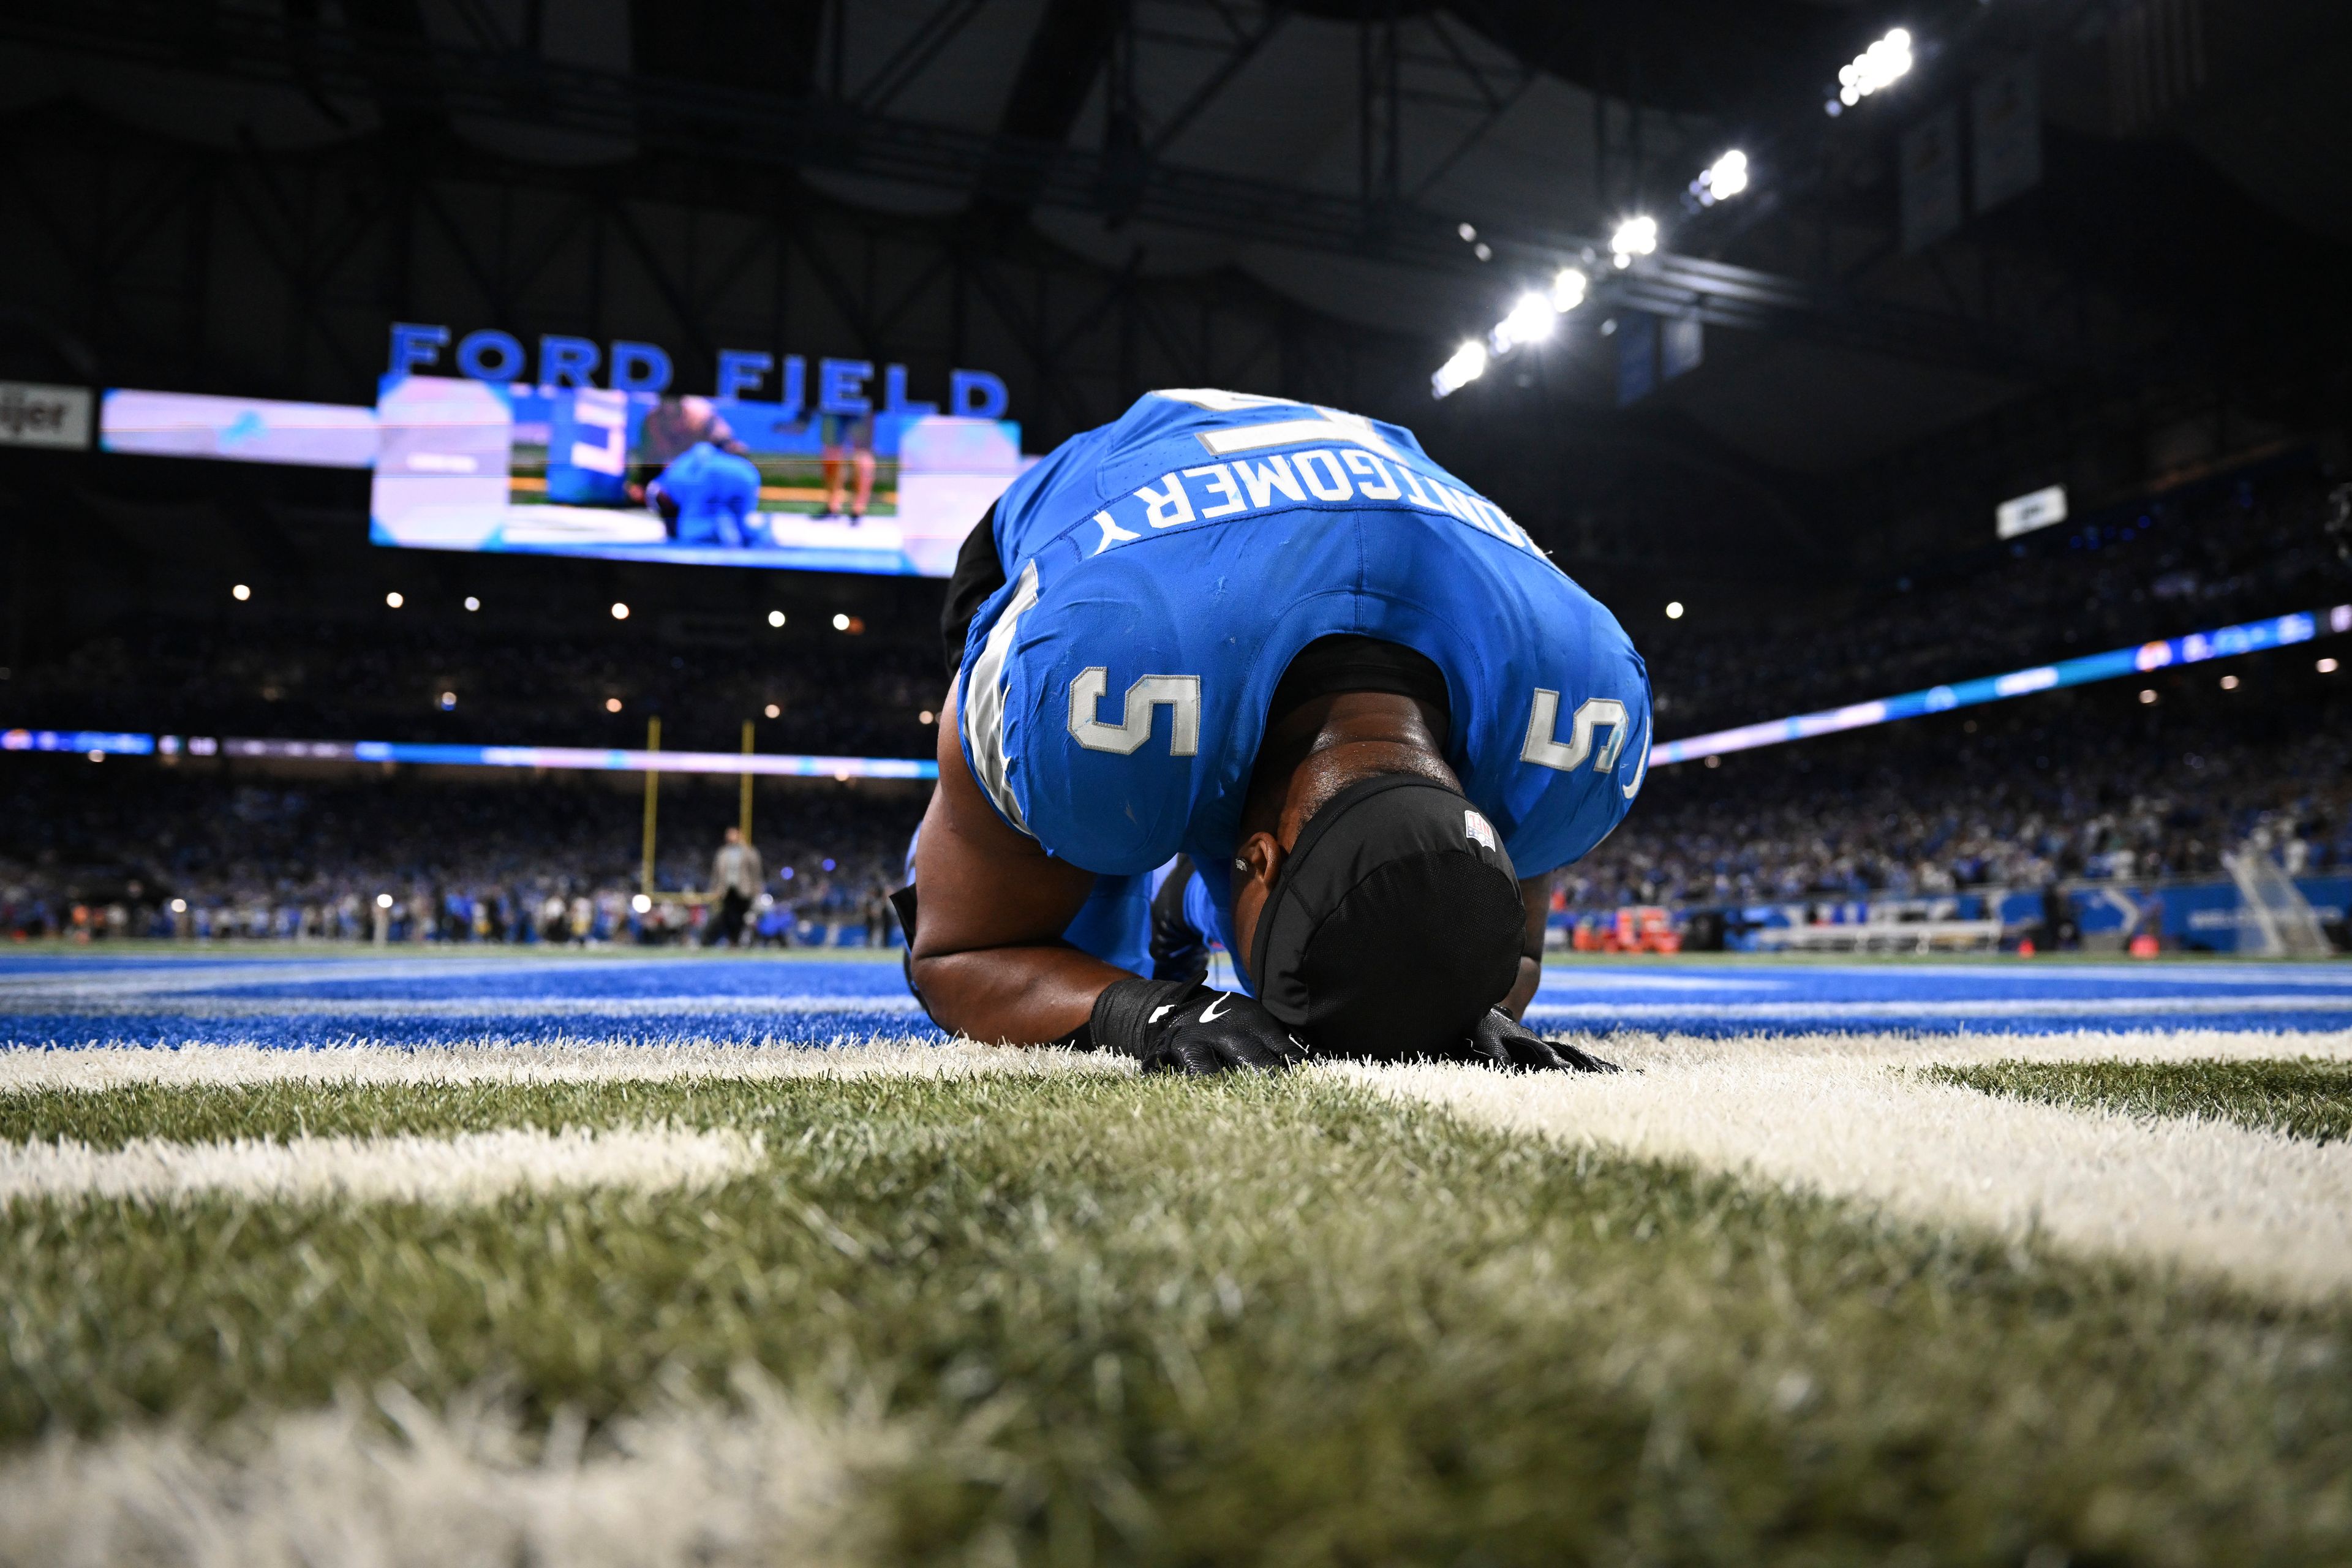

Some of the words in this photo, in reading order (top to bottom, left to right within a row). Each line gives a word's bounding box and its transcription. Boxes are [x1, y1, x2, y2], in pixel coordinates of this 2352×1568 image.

[390, 322, 674, 392] FORD
[717, 349, 1009, 420] FIELD
[1066, 666, 1200, 756] 5
[1519, 687, 1629, 774] 5
[1468, 814, 1491, 837] NFL
